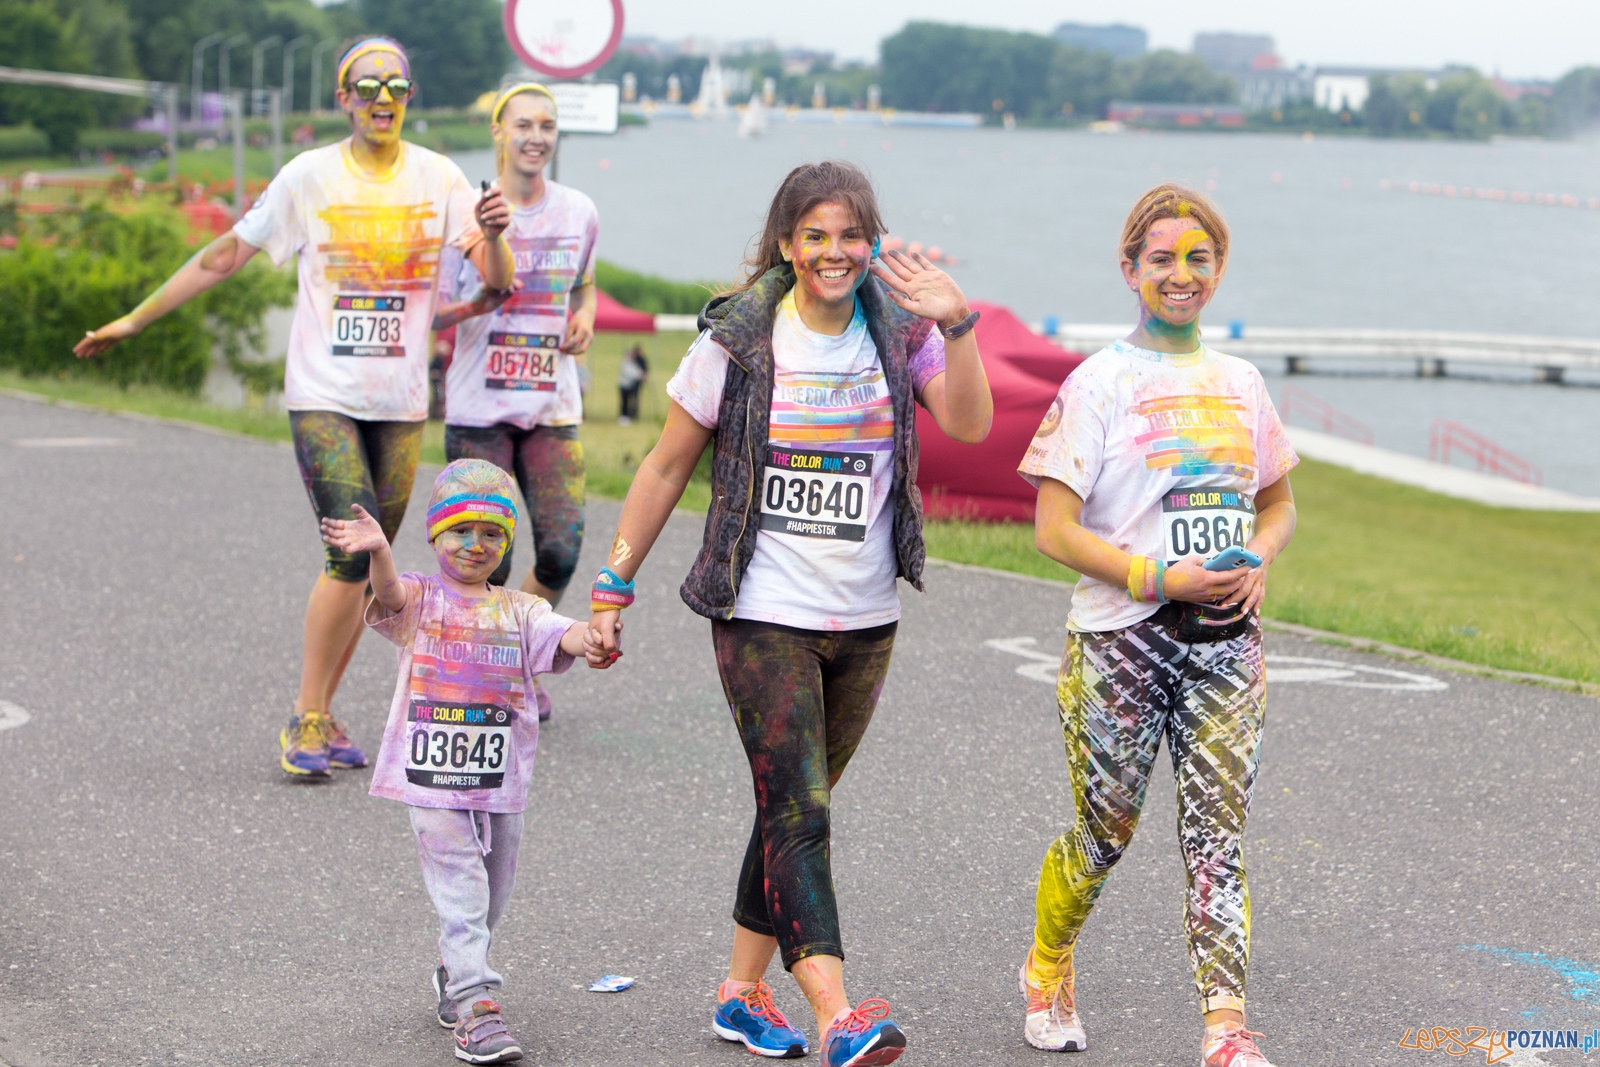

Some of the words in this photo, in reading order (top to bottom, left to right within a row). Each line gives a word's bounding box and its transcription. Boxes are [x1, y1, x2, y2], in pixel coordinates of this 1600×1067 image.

[338, 316, 400, 342] 05783
[491, 351, 554, 377] 05784
[781, 386, 804, 403] THE
[805, 386, 848, 407] COLOR
[1145, 412, 1173, 431] THE
[1172, 409, 1213, 427] COLOR
[772, 451, 790, 466] THE
[791, 454, 821, 469] COLOR
[765, 474, 864, 520] 03640
[1170, 494, 1188, 507] THE
[1189, 492, 1221, 506] COLOR
[786, 520, 837, 536] #HAPPIEST5K
[443, 641, 489, 662] COLOR
[415, 706, 432, 719] THE
[433, 707, 464, 721] COLOR
[411, 729, 505, 769] 03643
[433, 774, 481, 786] #HAPPIEST5K
